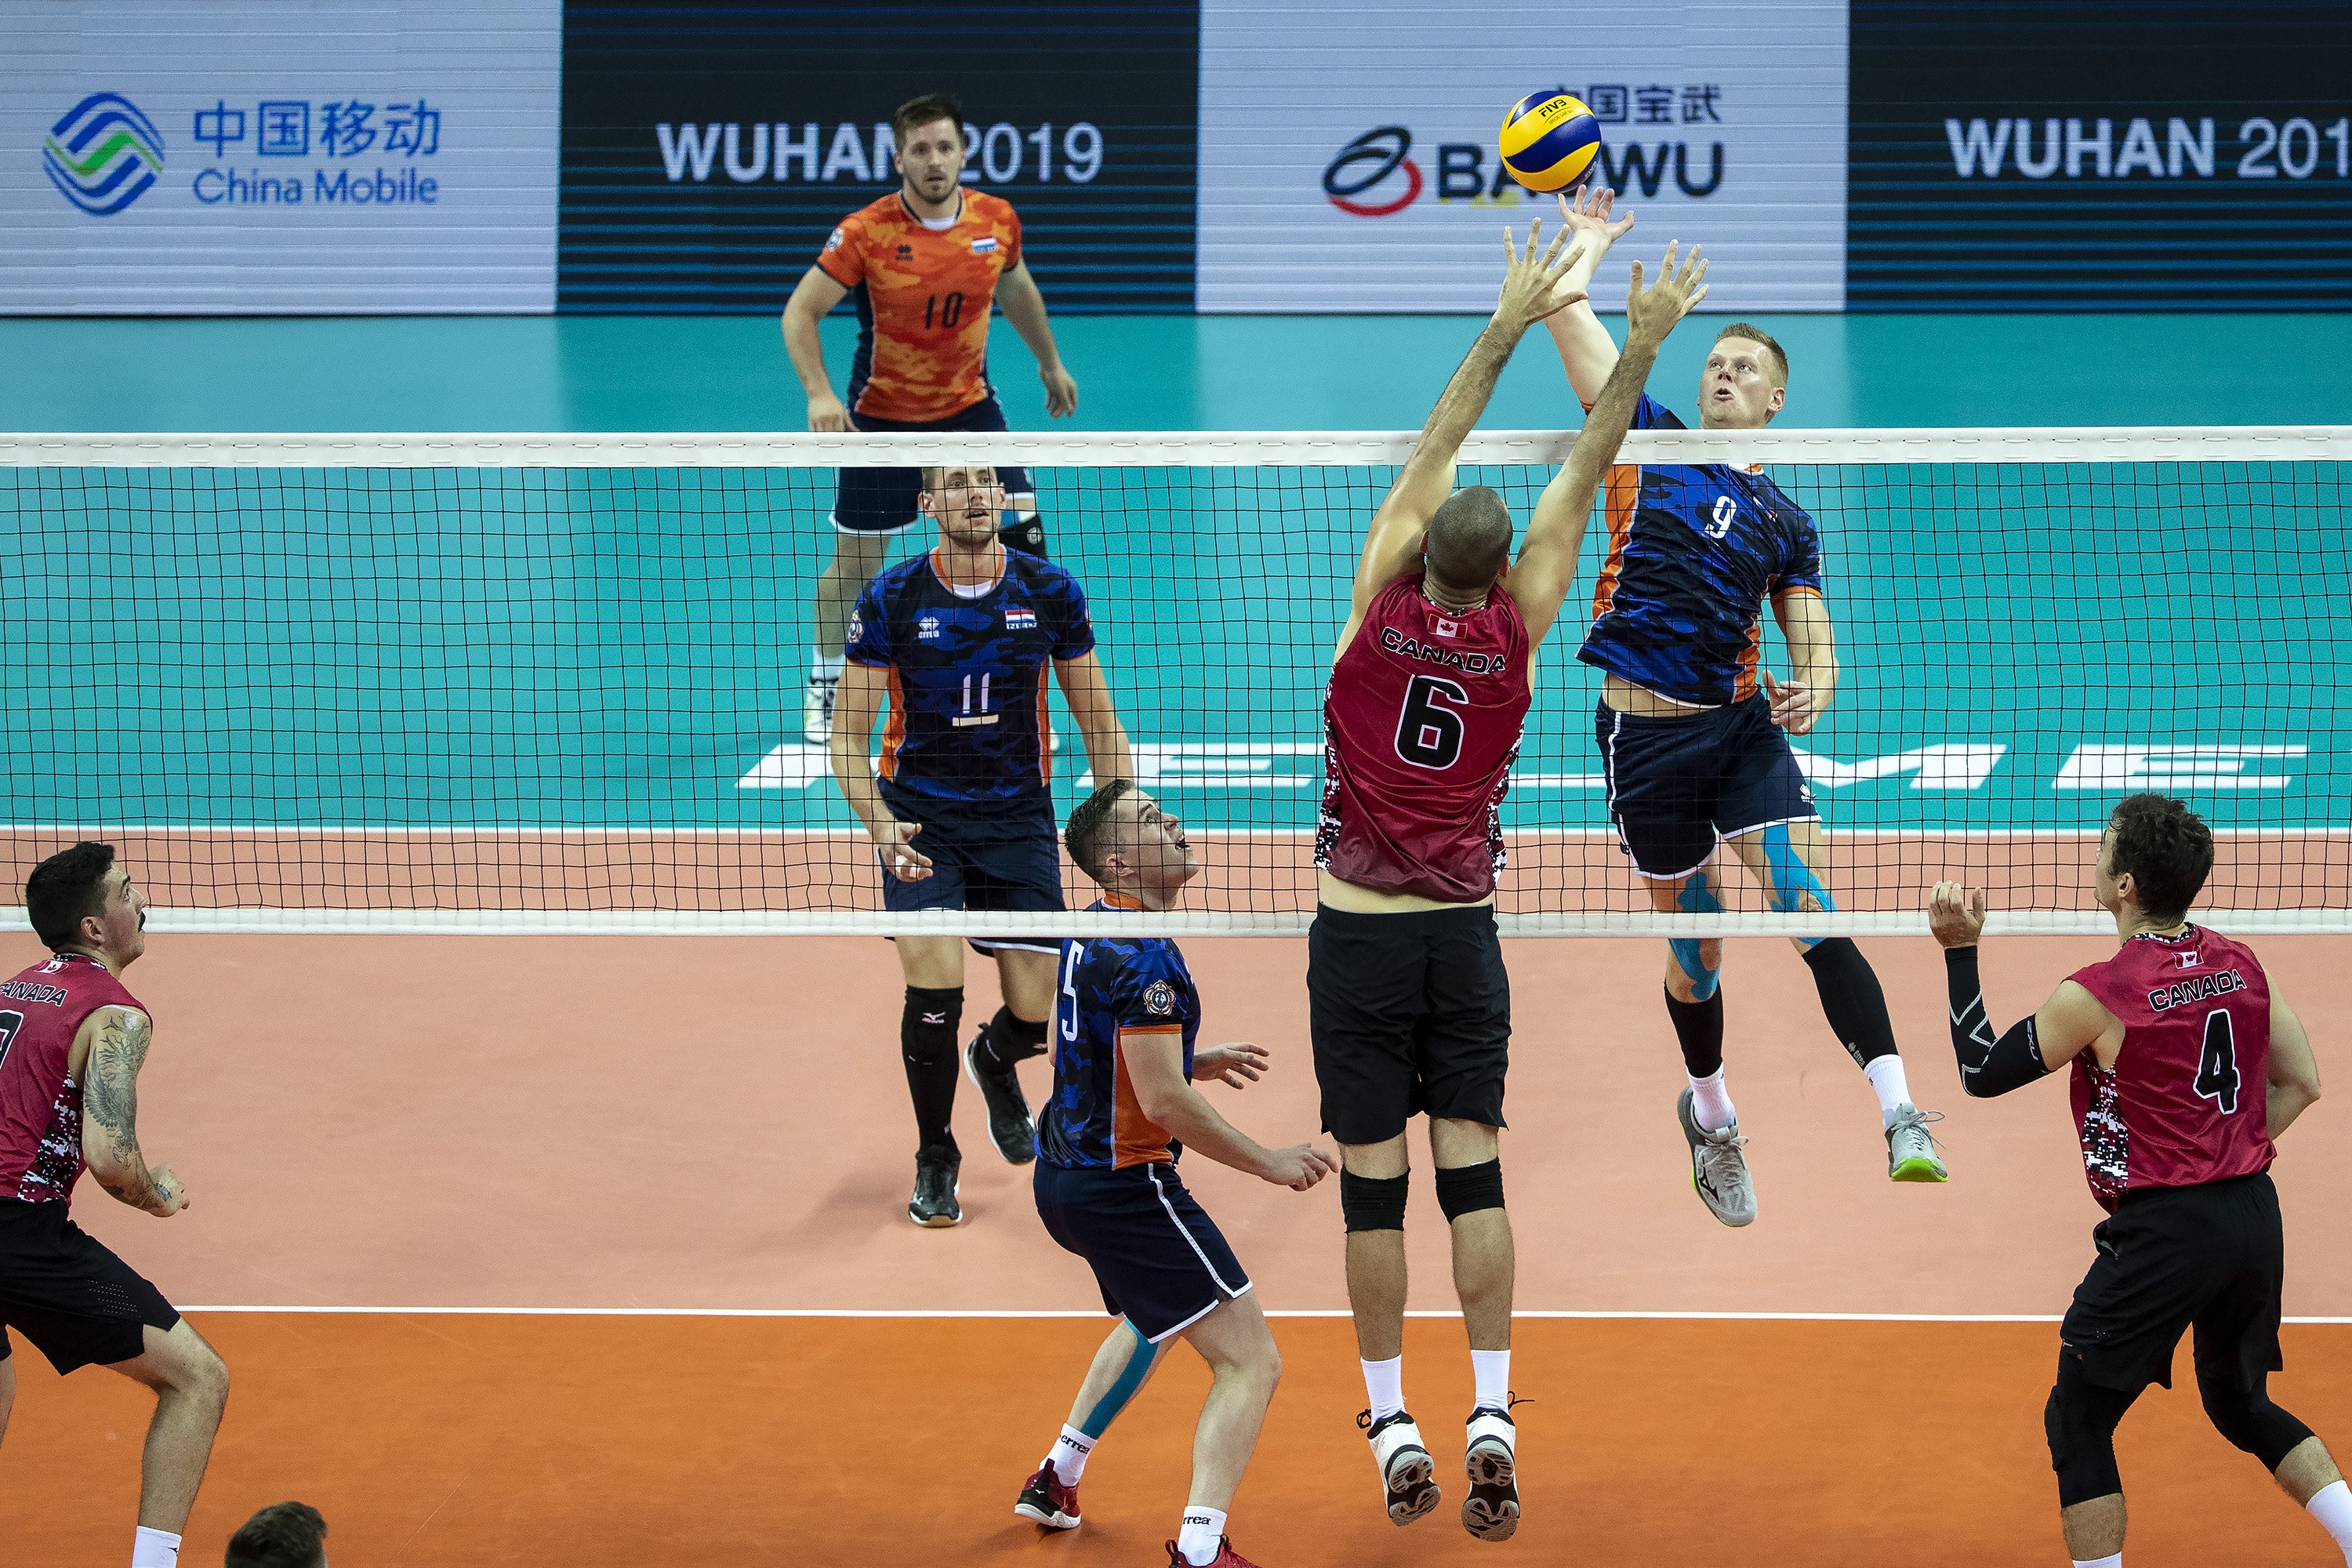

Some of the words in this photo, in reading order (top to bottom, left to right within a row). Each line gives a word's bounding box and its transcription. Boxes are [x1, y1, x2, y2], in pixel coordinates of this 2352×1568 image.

[1538, 99, 1567, 117] FIVB
[1555, 83, 1722, 123] 国宝武
[194, 99, 441, 158] 中国移动
[1945, 117, 2216, 179] WUHAN
[194, 168, 303, 205] China
[315, 167, 438, 205] Mobile
[924, 291, 965, 330] 10
[1704, 495, 1737, 539] 9
[1380, 626, 1506, 675] CANADA
[962, 672, 990, 714] 11
[1393, 673, 1470, 771] 6
[2147, 968, 2248, 1012] CANADA
[2192, 1007, 2241, 1116] 4
